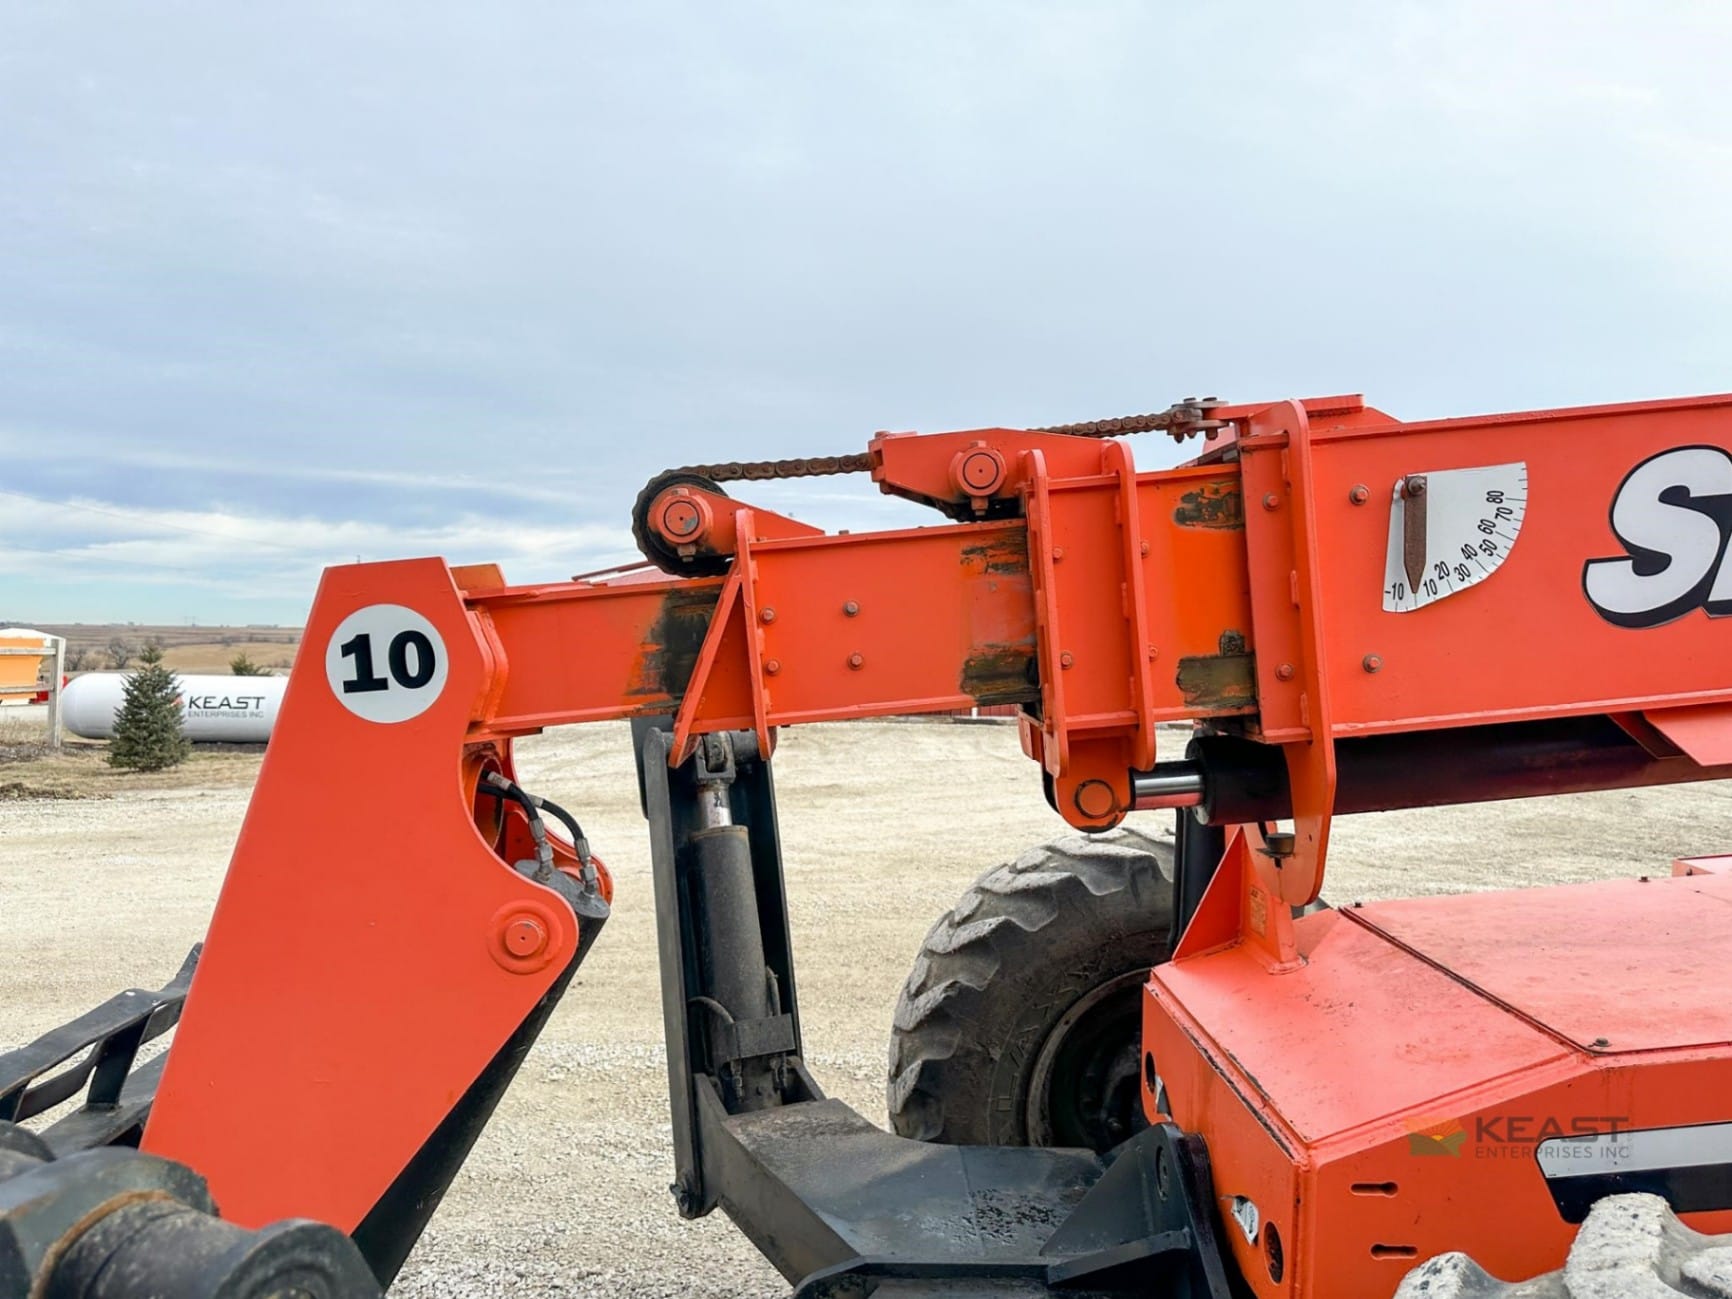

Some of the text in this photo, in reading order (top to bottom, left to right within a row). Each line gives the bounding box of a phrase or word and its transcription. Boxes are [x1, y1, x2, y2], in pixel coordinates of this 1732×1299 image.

[1384, 490, 1513, 601] -10 10 20 30 40 50 60 70 80
[1582, 443, 1732, 629] S
[188, 696, 265, 709] KEAST
[340, 630, 436, 694] 10
